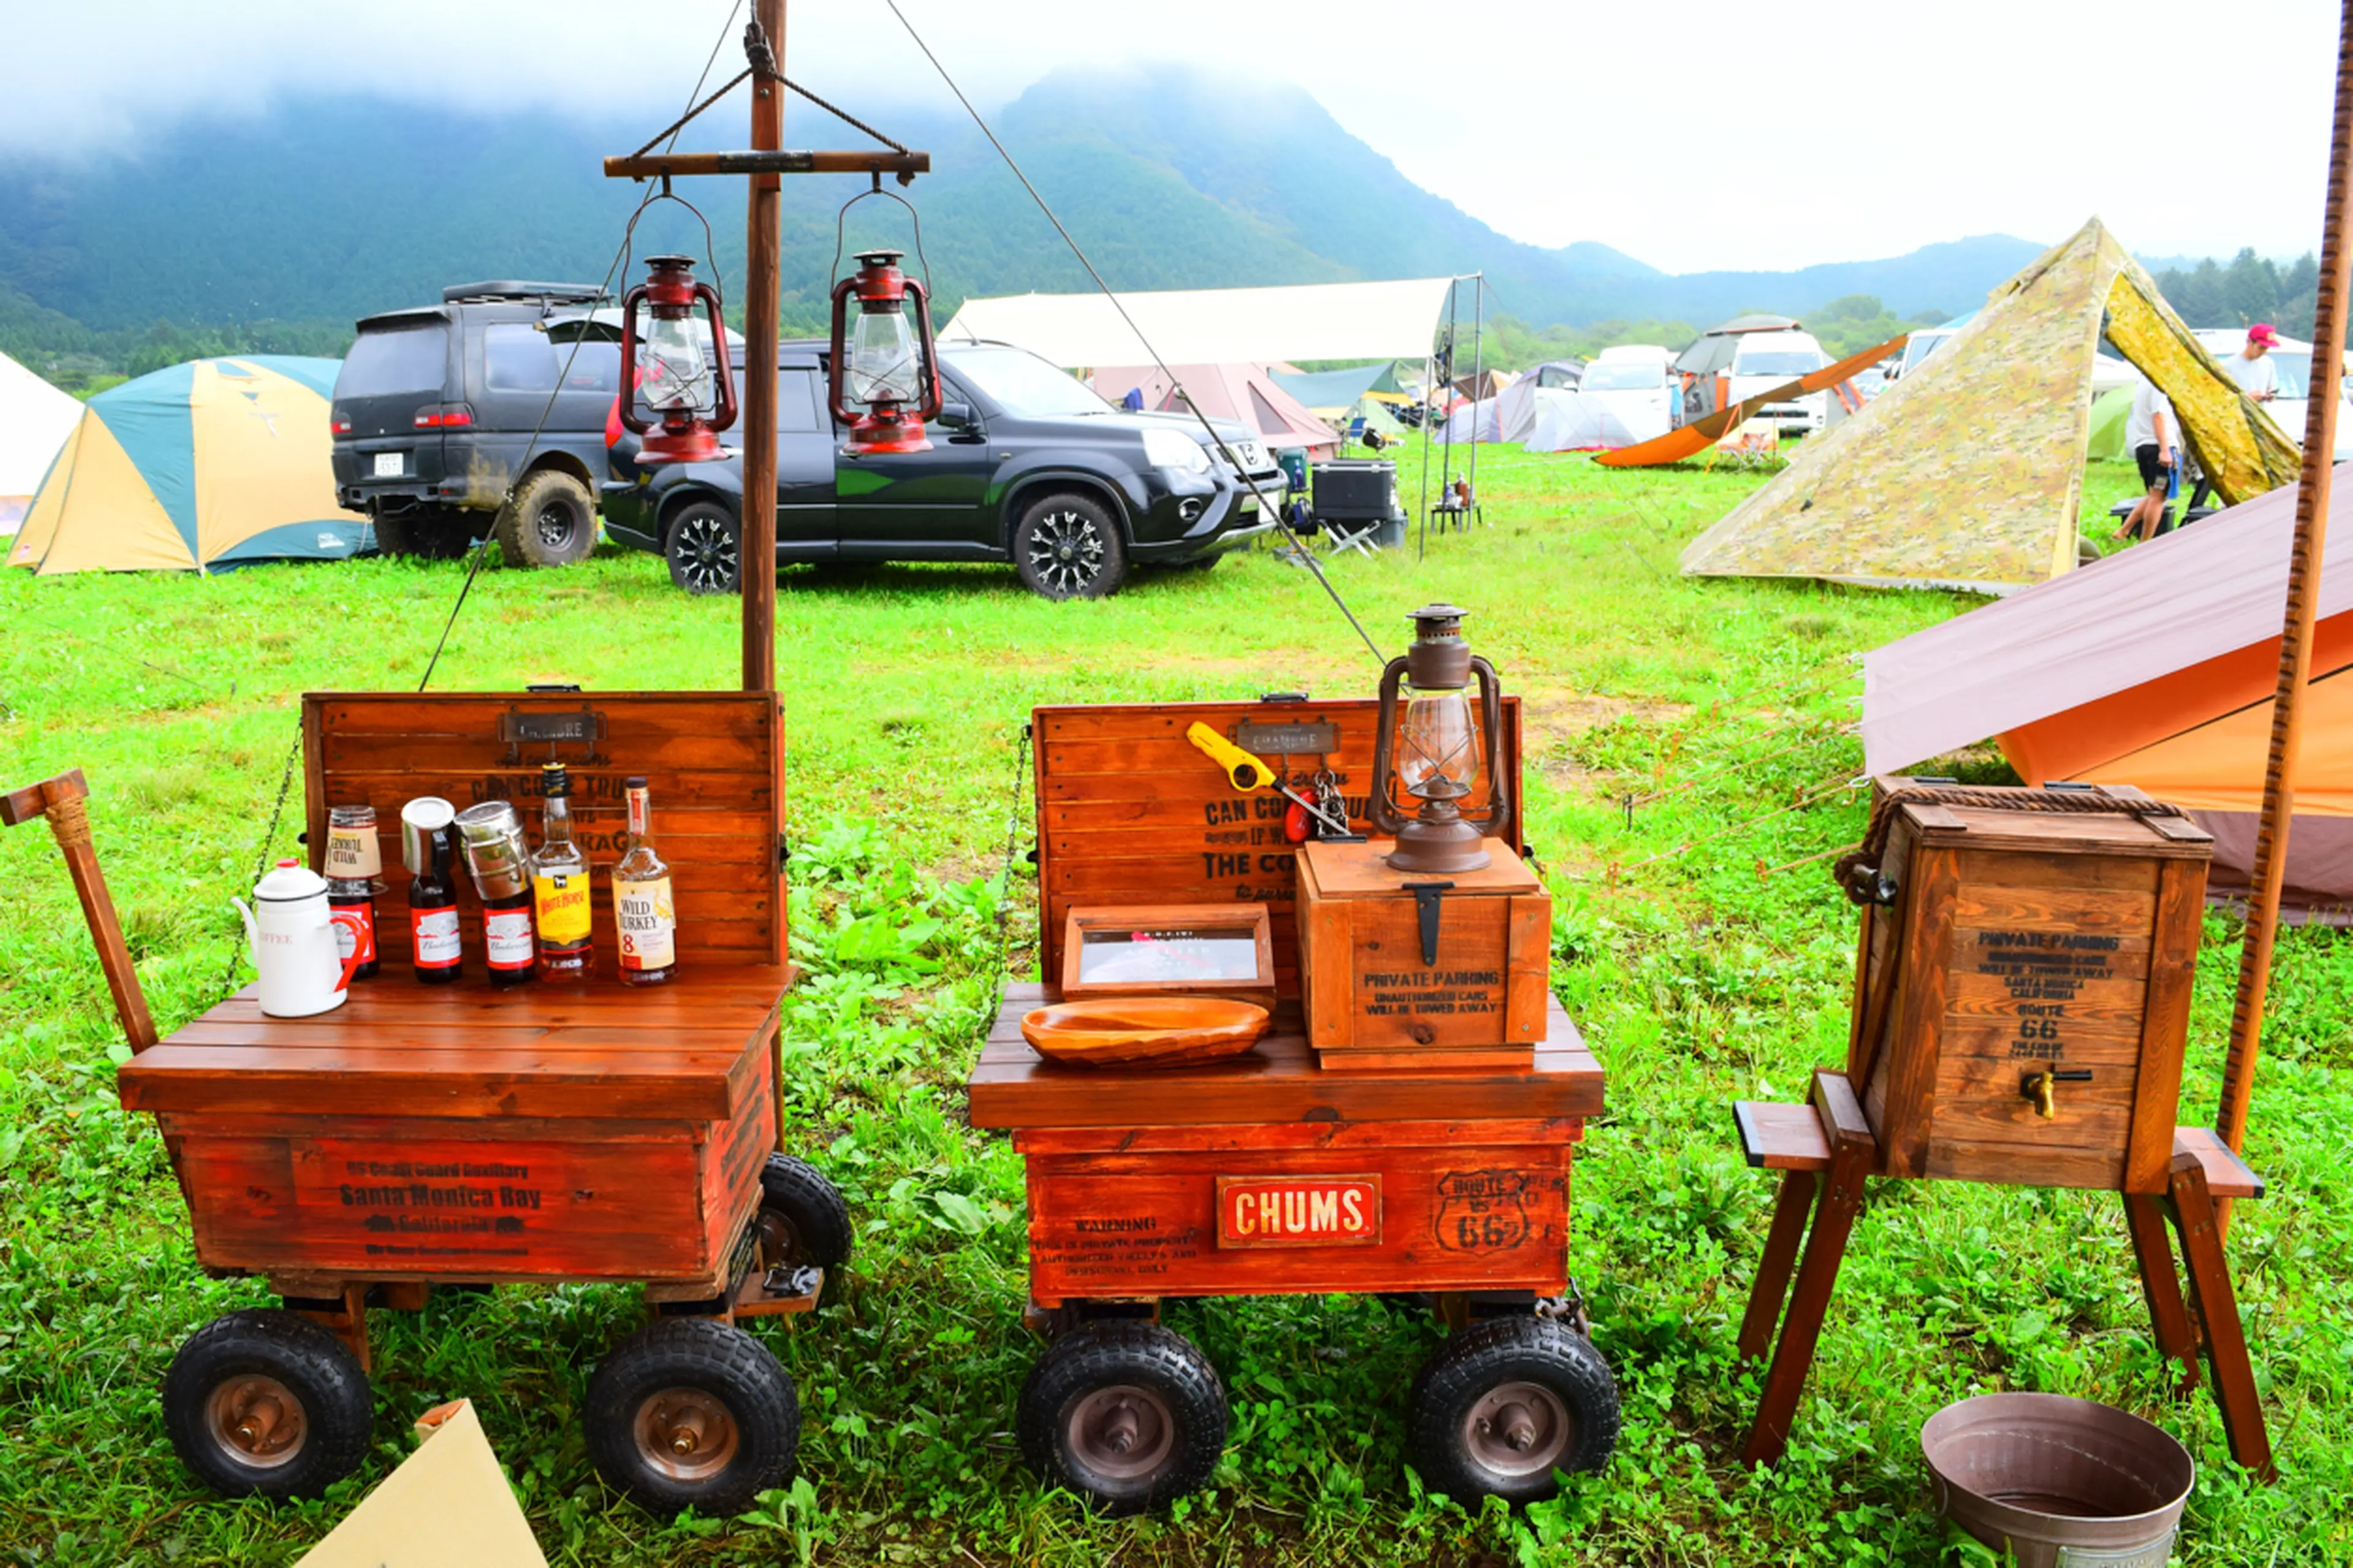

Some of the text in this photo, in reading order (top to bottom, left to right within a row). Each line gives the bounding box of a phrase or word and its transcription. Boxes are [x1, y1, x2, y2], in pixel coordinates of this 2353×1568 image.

[1205, 800, 1246, 825] CAN
[1251, 827, 1265, 845] IF
[1202, 852, 1250, 879] THE
[620, 899, 650, 915] WILD
[618, 912, 657, 930] TURKEY
[623, 934, 634, 953] 8
[1979, 931, 2119, 950] PRIVATE PARKING
[1364, 970, 1499, 987] PRIVATE PARKING
[2074, 966, 2113, 979] AWAY
[1365, 1004, 1394, 1015] WILL
[1458, 1002, 1496, 1013] AWAY
[2017, 1004, 2064, 1017] ROUTE
[2020, 1020, 2058, 1040] 66
[1453, 1176, 1507, 1194] ROUTE
[340, 1184, 540, 1210] Santa Monica Bay
[1235, 1189, 1363, 1235] CHUMS
[1074, 1217, 1157, 1232] WARNING
[1458, 1214, 1505, 1248] 66
